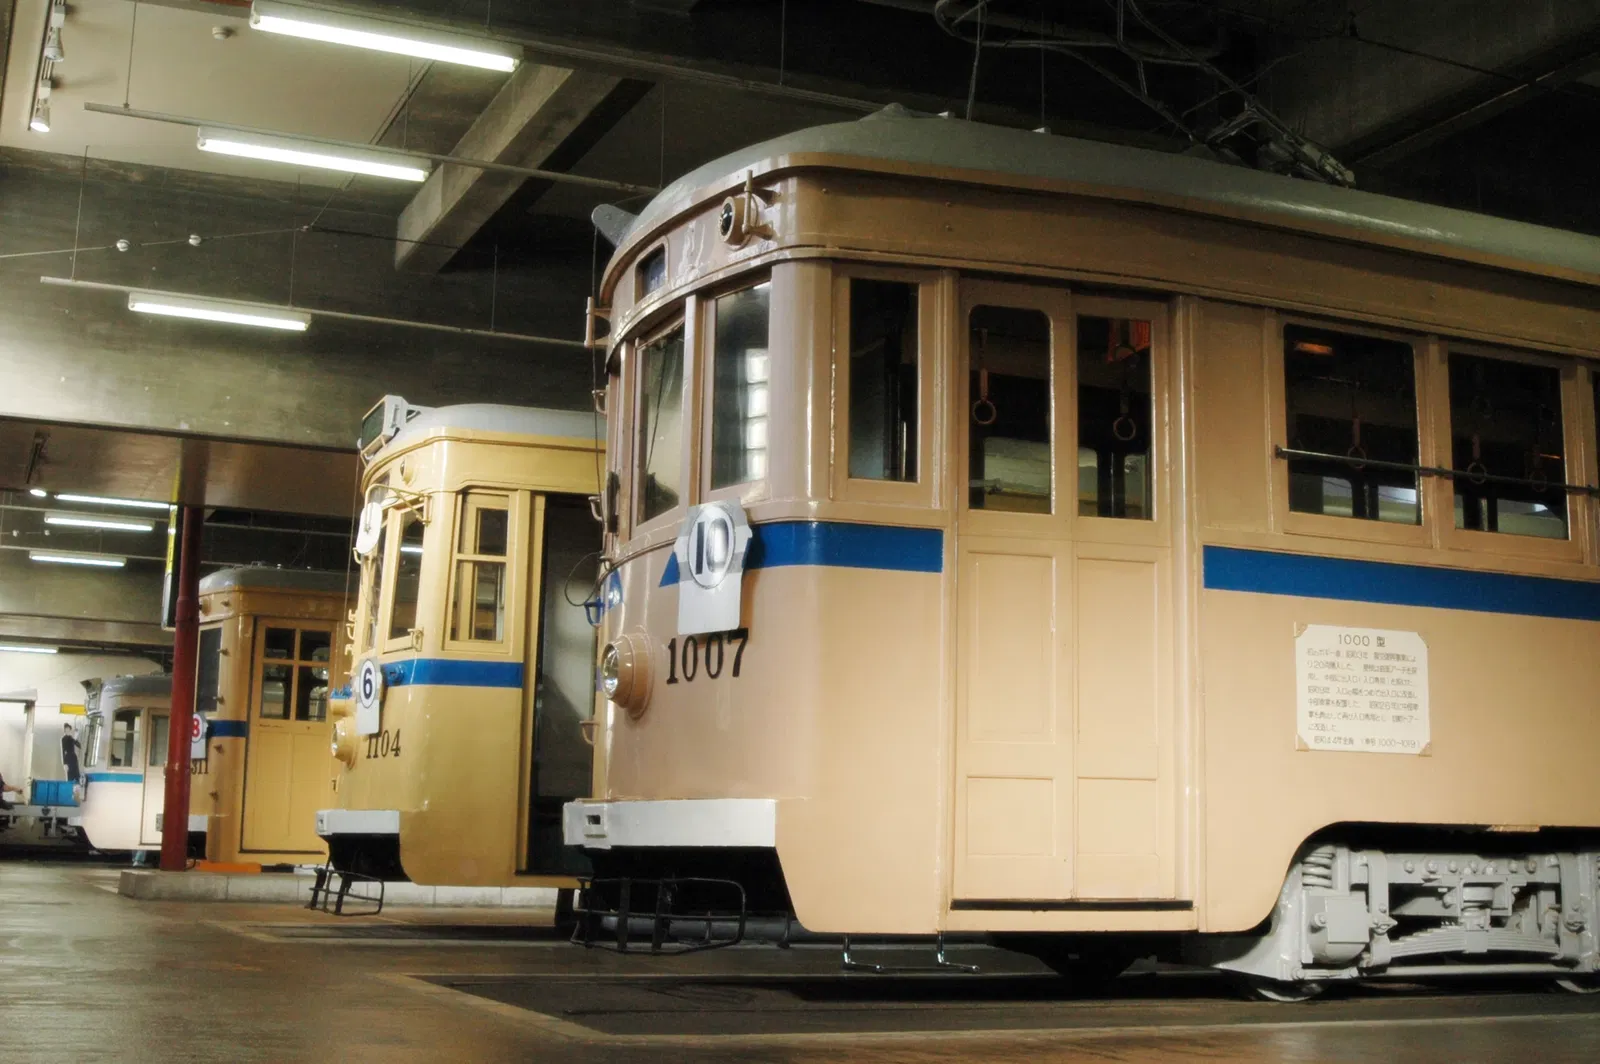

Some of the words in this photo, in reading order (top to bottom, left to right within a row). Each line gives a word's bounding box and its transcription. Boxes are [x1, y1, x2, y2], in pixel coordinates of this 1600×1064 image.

[695, 517, 729, 575] 10
[666, 628, 749, 684] 1007
[1338, 634, 1370, 647] 1000
[363, 667, 373, 699] 6
[366, 728, 401, 759] 1104
